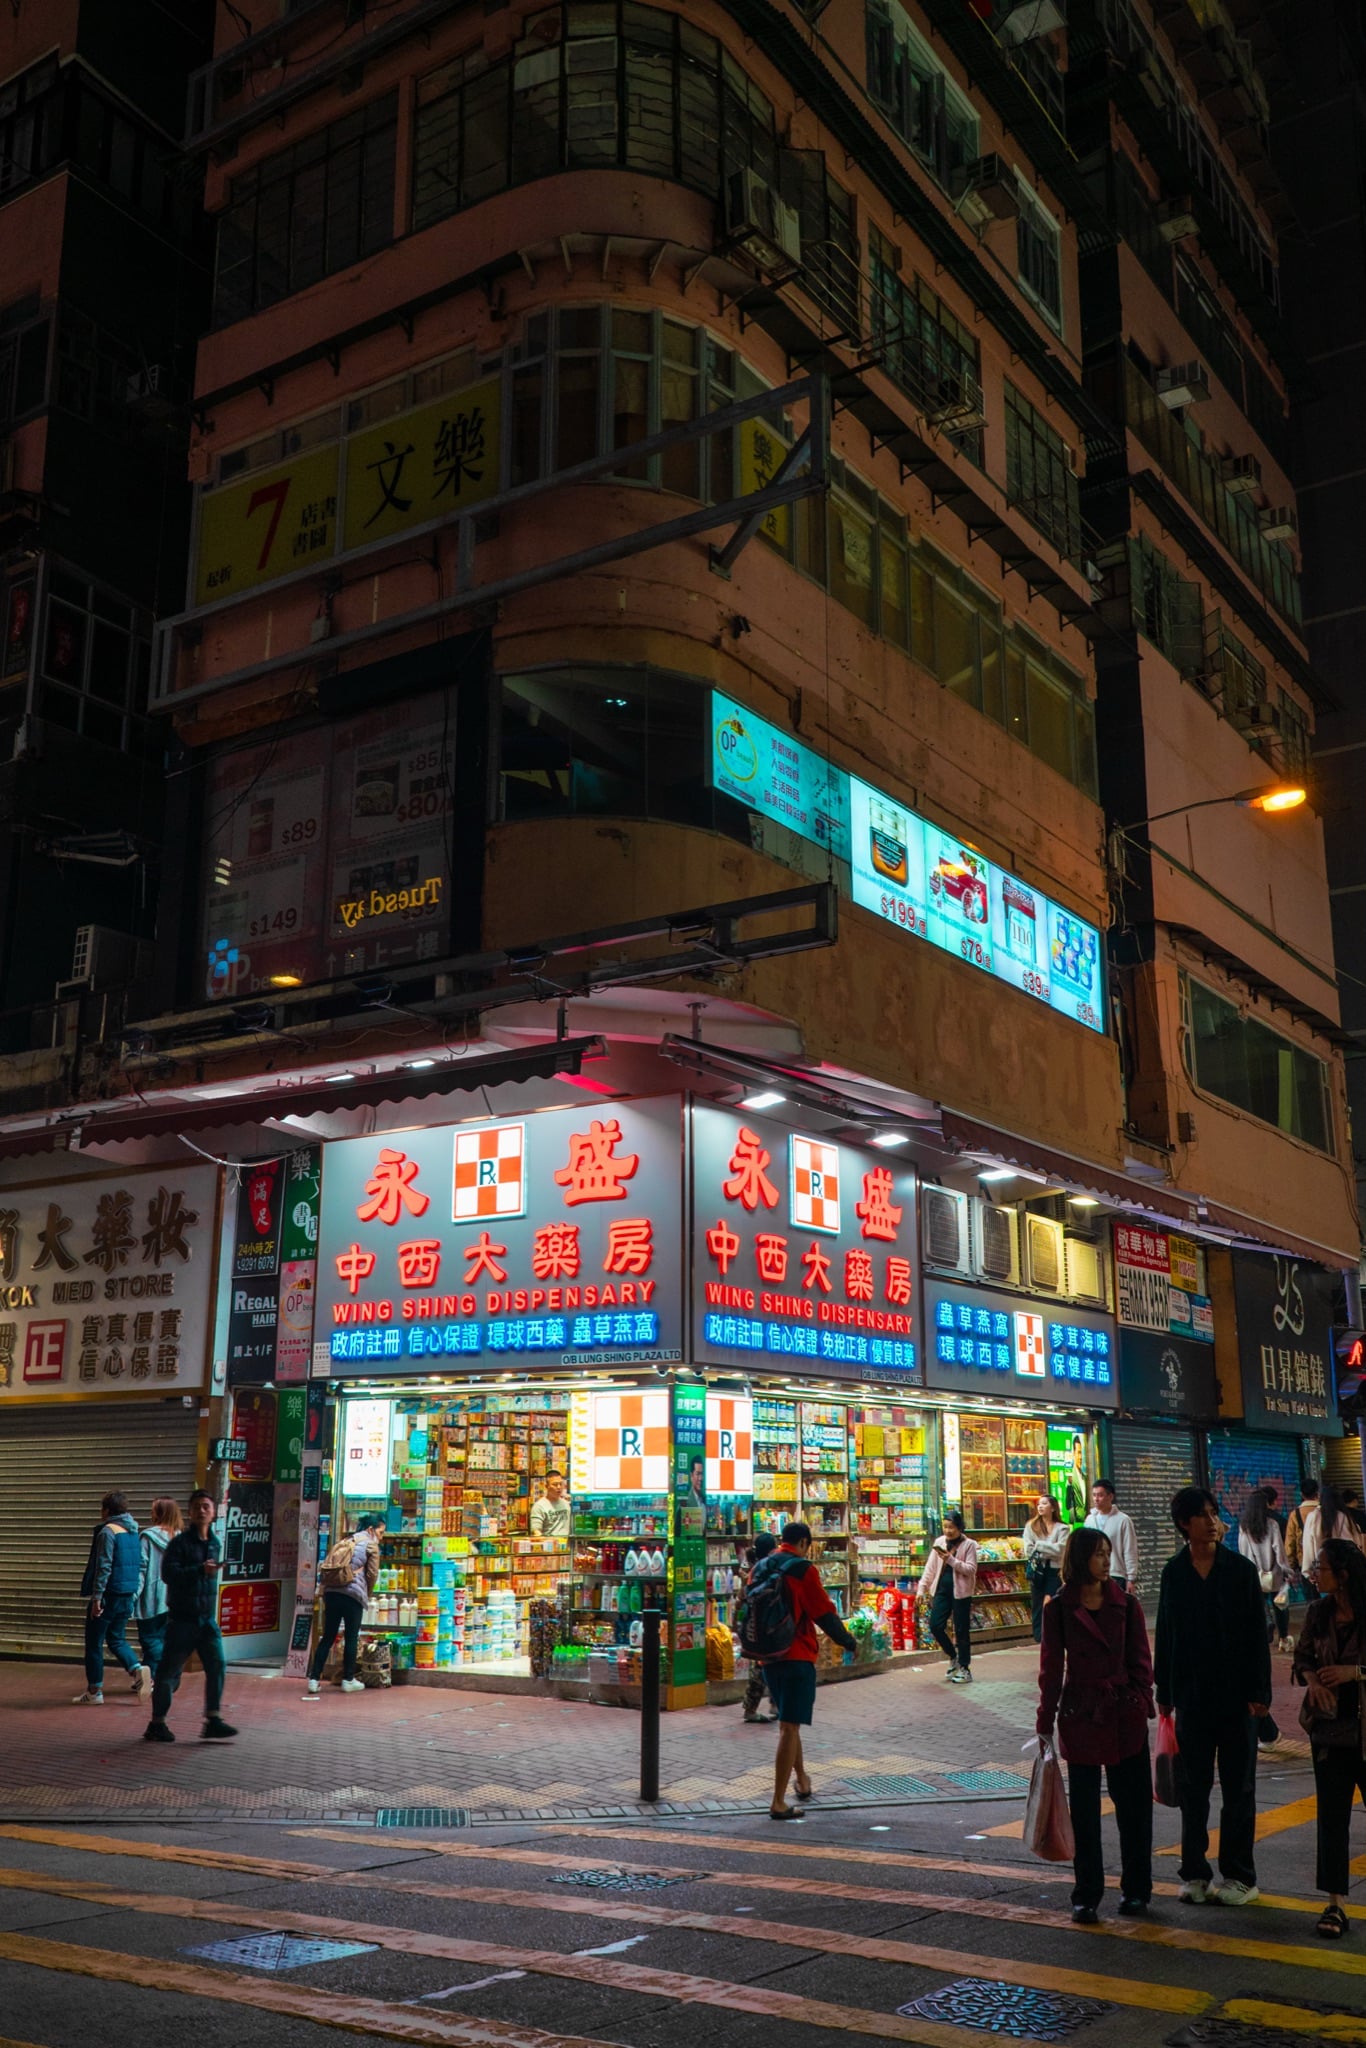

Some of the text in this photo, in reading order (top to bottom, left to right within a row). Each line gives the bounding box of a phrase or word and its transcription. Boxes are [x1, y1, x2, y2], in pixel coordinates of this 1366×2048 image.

[247, 478, 290, 570] 7
[721, 730, 736, 753] OP
[281, 817, 317, 846] $89
[249, 906, 297, 938] $149
[335, 1218, 655, 1296] 中西大藥房
[1118, 1227, 1168, 1259] 敬華物業
[706, 1219, 913, 1306] 中西大藥房
[52, 1280, 94, 1303] MED
[104, 1273, 174, 1299] STORE
[234, 1290, 277, 1311] REGAL
[286, 1293, 303, 1313] OP
[333, 1281, 655, 1323] WING SHING DISPENSARY
[1119, 1265, 1132, 1322] 出租
[252, 1313, 277, 1325] HAIR
[705, 1282, 913, 1334] WING SHING DISPENSARY
[939, 1302, 1009, 1338] 蟲草燕窩
[81, 1308, 182, 1347] 貨真價實
[331, 1327, 401, 1358] 政府註冊
[408, 1322, 480, 1354] 信心保證
[486, 1317, 565, 1348] 環球西藥
[572, 1312, 655, 1345] 蟲草燕窩
[708, 1315, 764, 1349] 政府註冊
[768, 1323, 818, 1355] 信心保證
[78, 1344, 179, 1380] 信心保證
[579, 1353, 602, 1364] LUNG
[604, 1352, 632, 1363] SHING
[633, 1350, 662, 1361] PLAZA
[664, 1350, 681, 1360] LTD
[940, 1335, 1011, 1370] 環球西藥
[1052, 1354, 1111, 1384] 保健產品
[227, 1506, 271, 1529] REGAL
[244, 1530, 270, 1544] HAIR
